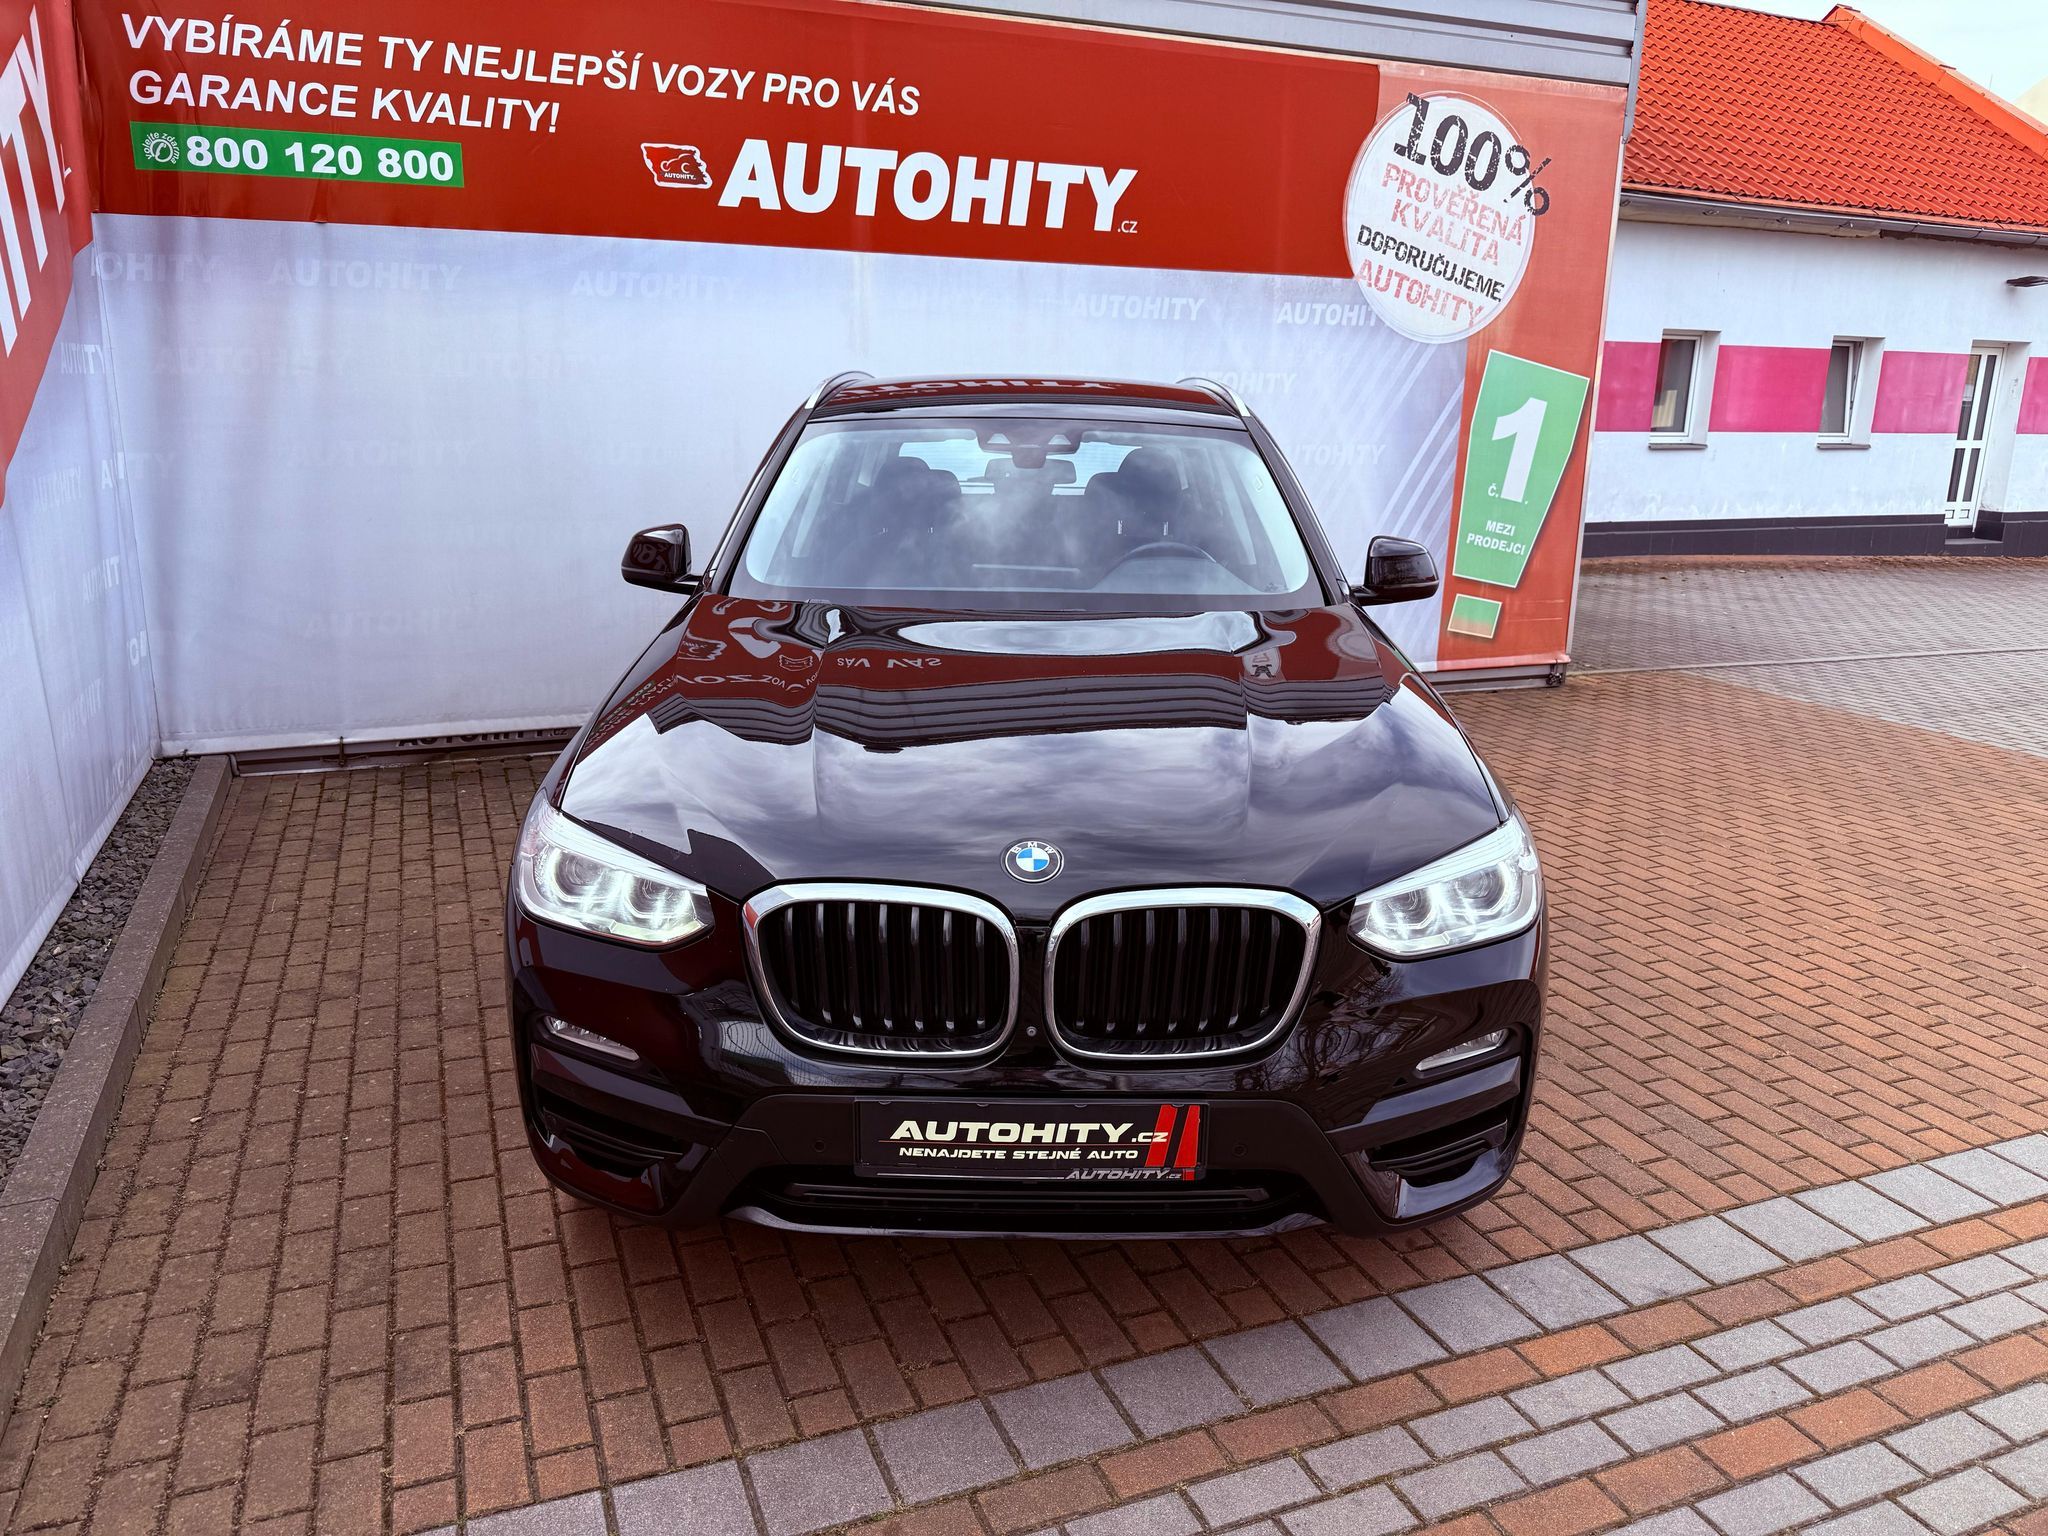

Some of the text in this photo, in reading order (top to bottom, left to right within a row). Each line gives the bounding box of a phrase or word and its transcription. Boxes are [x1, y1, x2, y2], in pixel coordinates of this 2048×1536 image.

[121, 13, 921, 117] VYBÍRÁME TY NEJLEPŠÍ VOZY PRO VÁS
[129, 69, 560, 133] GARANCE KVALITY!
[186, 135, 455, 182] 800 120 800
[1393, 92, 1552, 217] 100%
[1381, 162, 1527, 247] PROVĚŘENÁ
[1390, 198, 1500, 266] KVALITA
[268, 257, 463, 291] AUTOHITY
[1356, 224, 1506, 303] DOPORUČUJEME
[569, 270, 745, 300] AUTOHITY
[1355, 258, 1484, 328] AUTOHITY
[1071, 294, 1206, 321] AUTOHITY
[1277, 301, 1390, 327] AUTOHIT
[1466, 533, 1526, 556] PRODEJCI
[1485, 519, 1516, 537] MEZI
[1010, 841, 1056, 854] BMW
[899, 1147, 1139, 1160] NENAJDETE STEJNÉ AUTO
